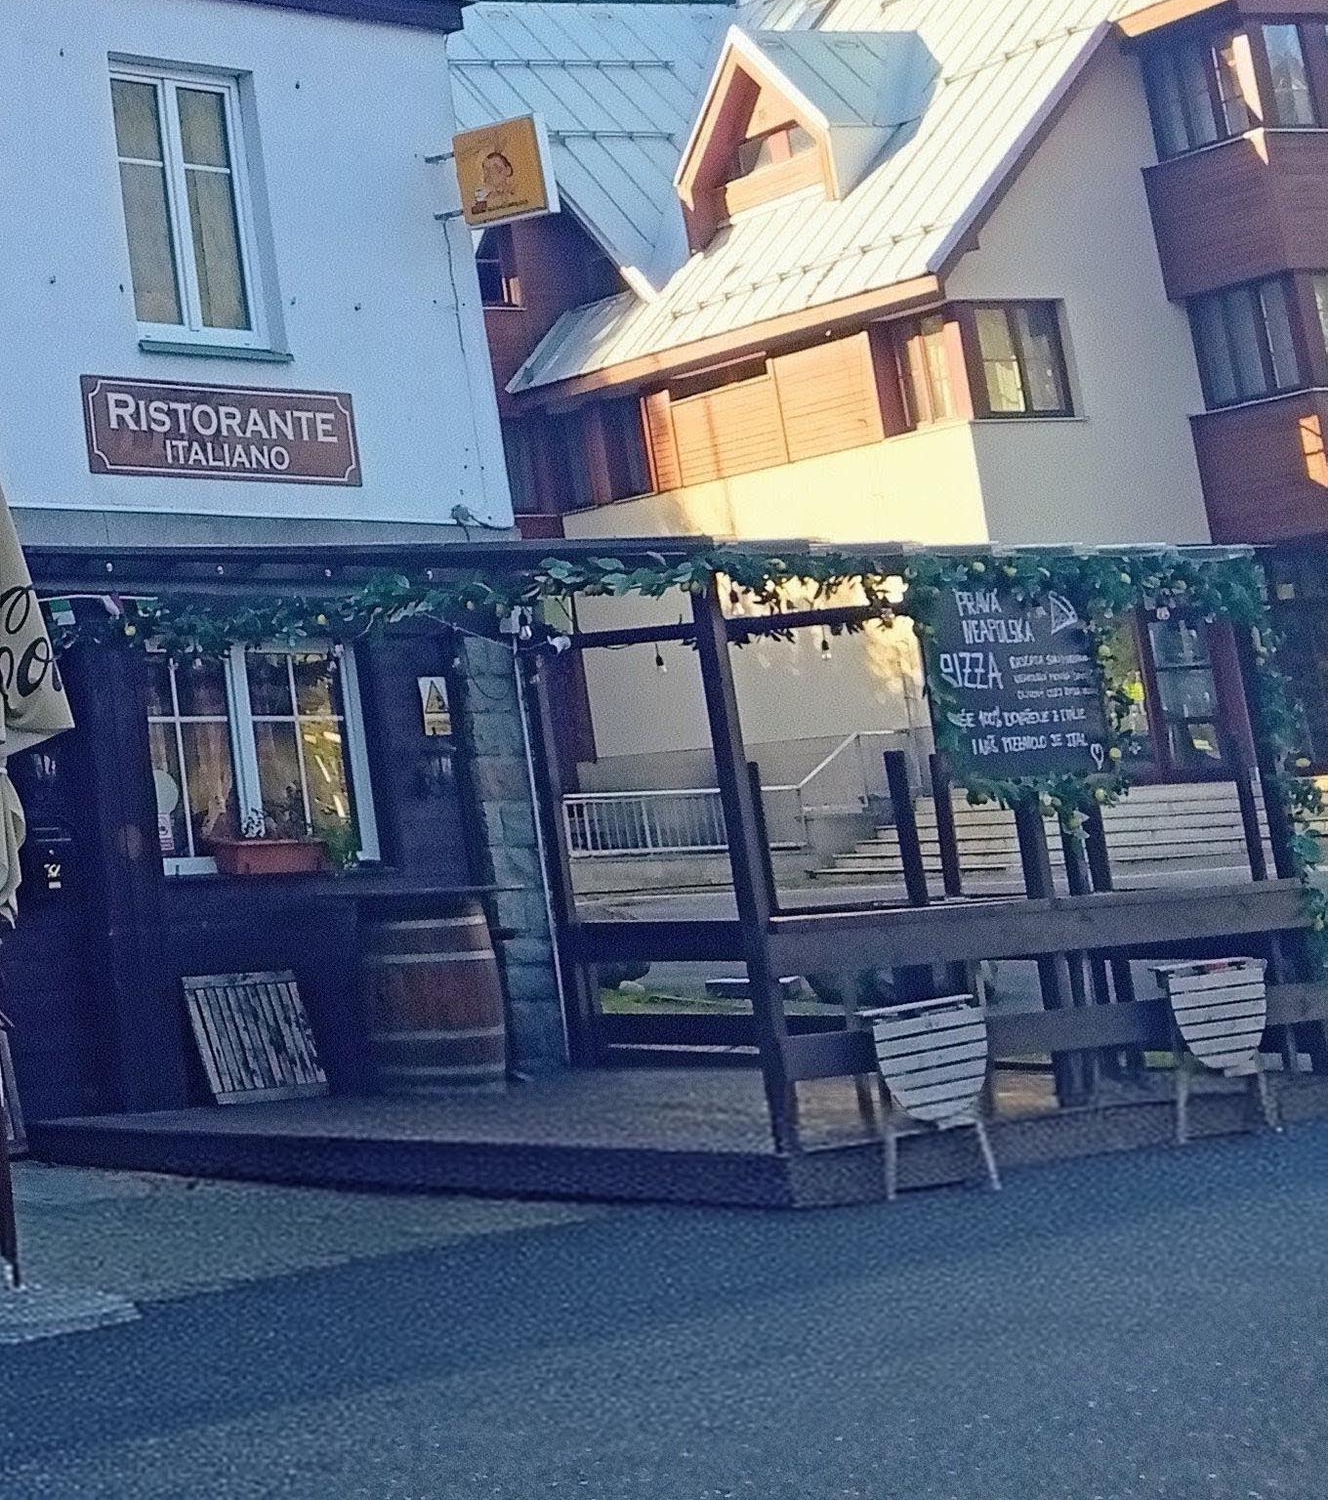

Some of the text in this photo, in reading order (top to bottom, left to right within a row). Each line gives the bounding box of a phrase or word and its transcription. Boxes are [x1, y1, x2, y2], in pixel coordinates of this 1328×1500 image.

[106, 392, 339, 443] RISTORANTE
[164, 439, 290, 470] ITALIANO
[940, 651, 1004, 690] PIZZA
